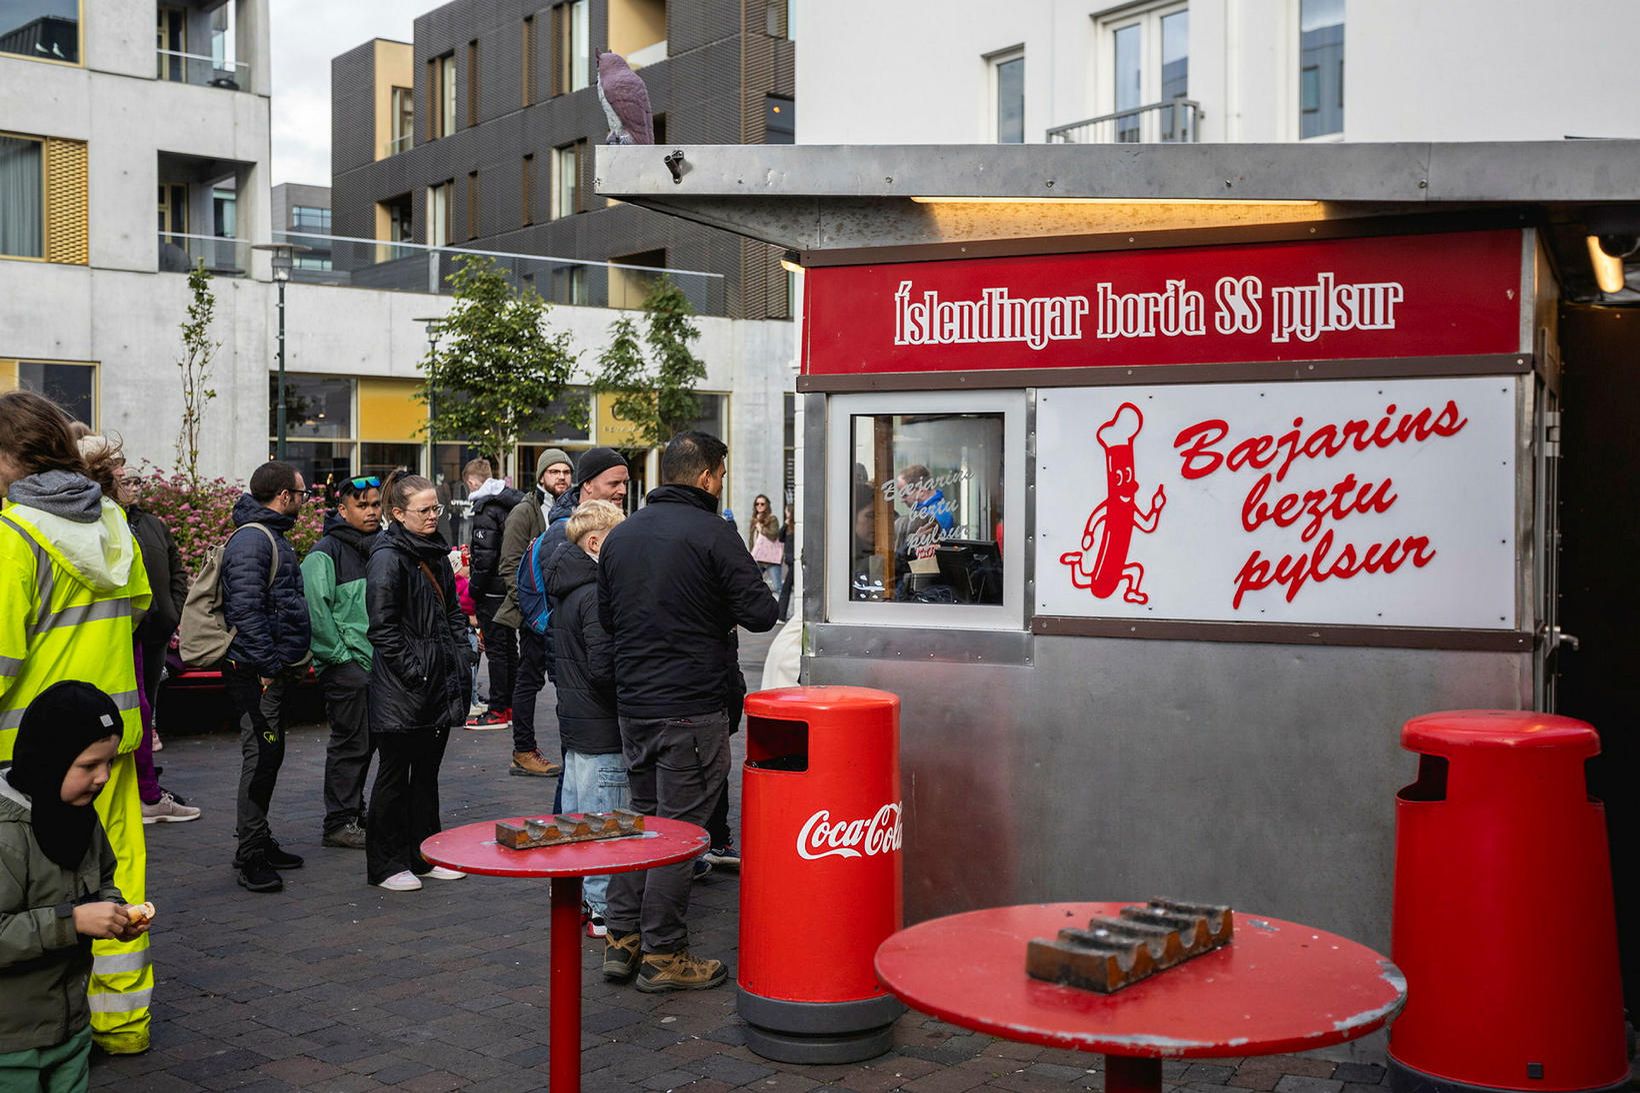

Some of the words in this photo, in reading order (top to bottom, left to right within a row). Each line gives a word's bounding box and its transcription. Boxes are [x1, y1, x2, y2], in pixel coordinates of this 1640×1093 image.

[894, 280, 1089, 351] Íslendingar
[1096, 279, 1207, 339] borða
[1214, 275, 1263, 335] SS
[1271, 271, 1404, 343] pylsur
[1173, 399, 1468, 482] Bæjarins
[908, 498, 959, 526] beztu
[1241, 472, 1398, 543] beztu
[1232, 528, 1436, 610] pylsur
